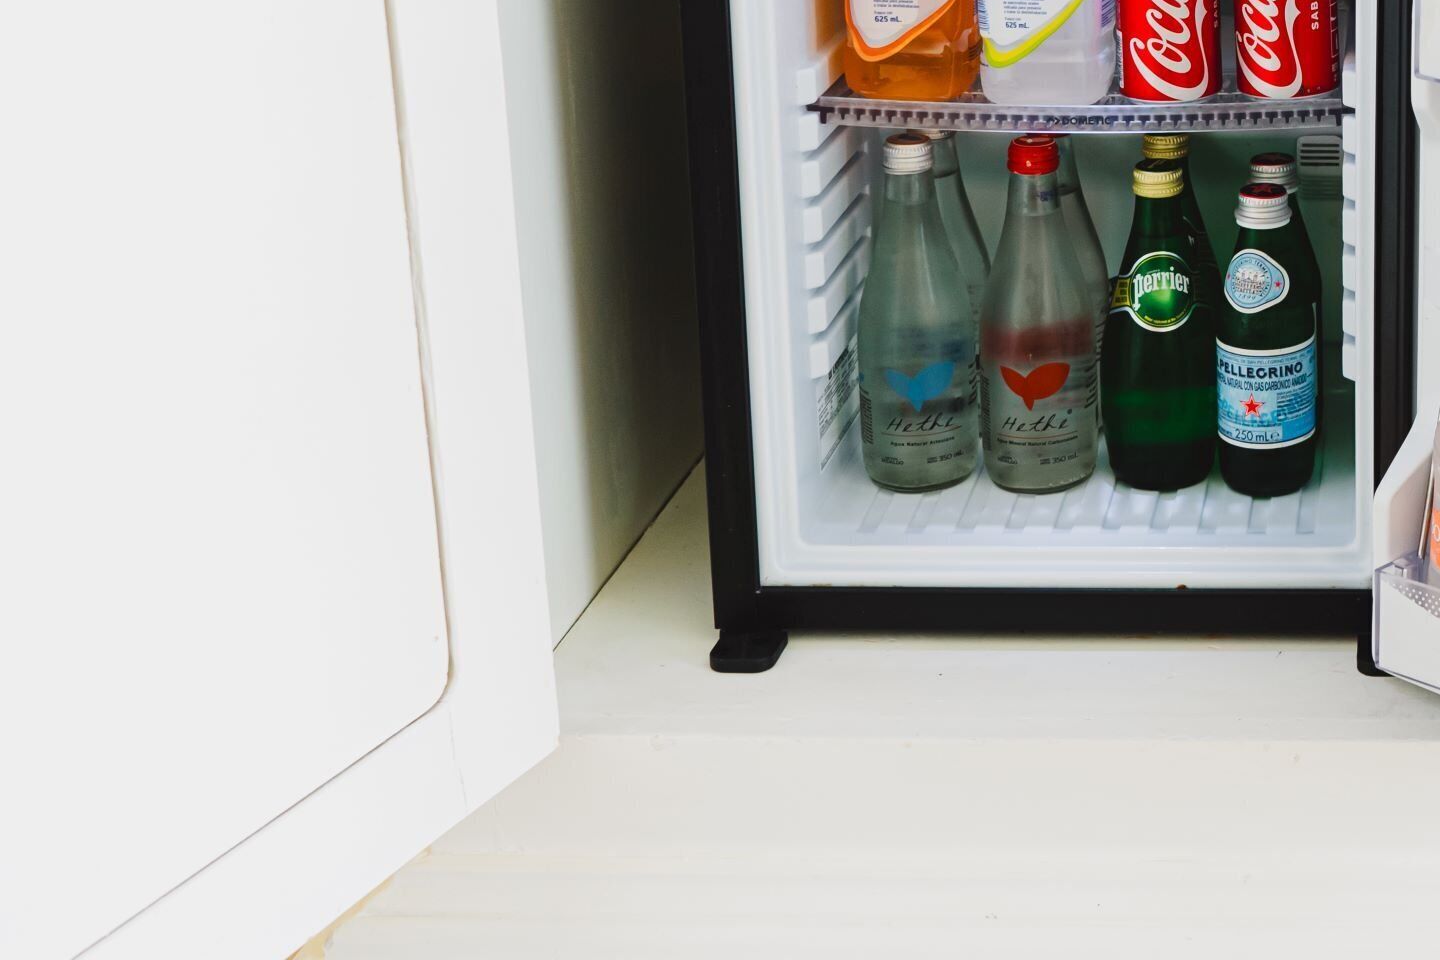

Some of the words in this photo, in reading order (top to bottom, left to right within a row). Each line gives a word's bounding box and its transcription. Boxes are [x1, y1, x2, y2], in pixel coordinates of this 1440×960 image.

[1062, 116, 1112, 125] DOMETIC
[1244, 380, 1254, 390] CON
[1254, 380, 1264, 392] GAS
[1235, 428, 1254, 440] 250
[1256, 432, 1269, 442] ml
